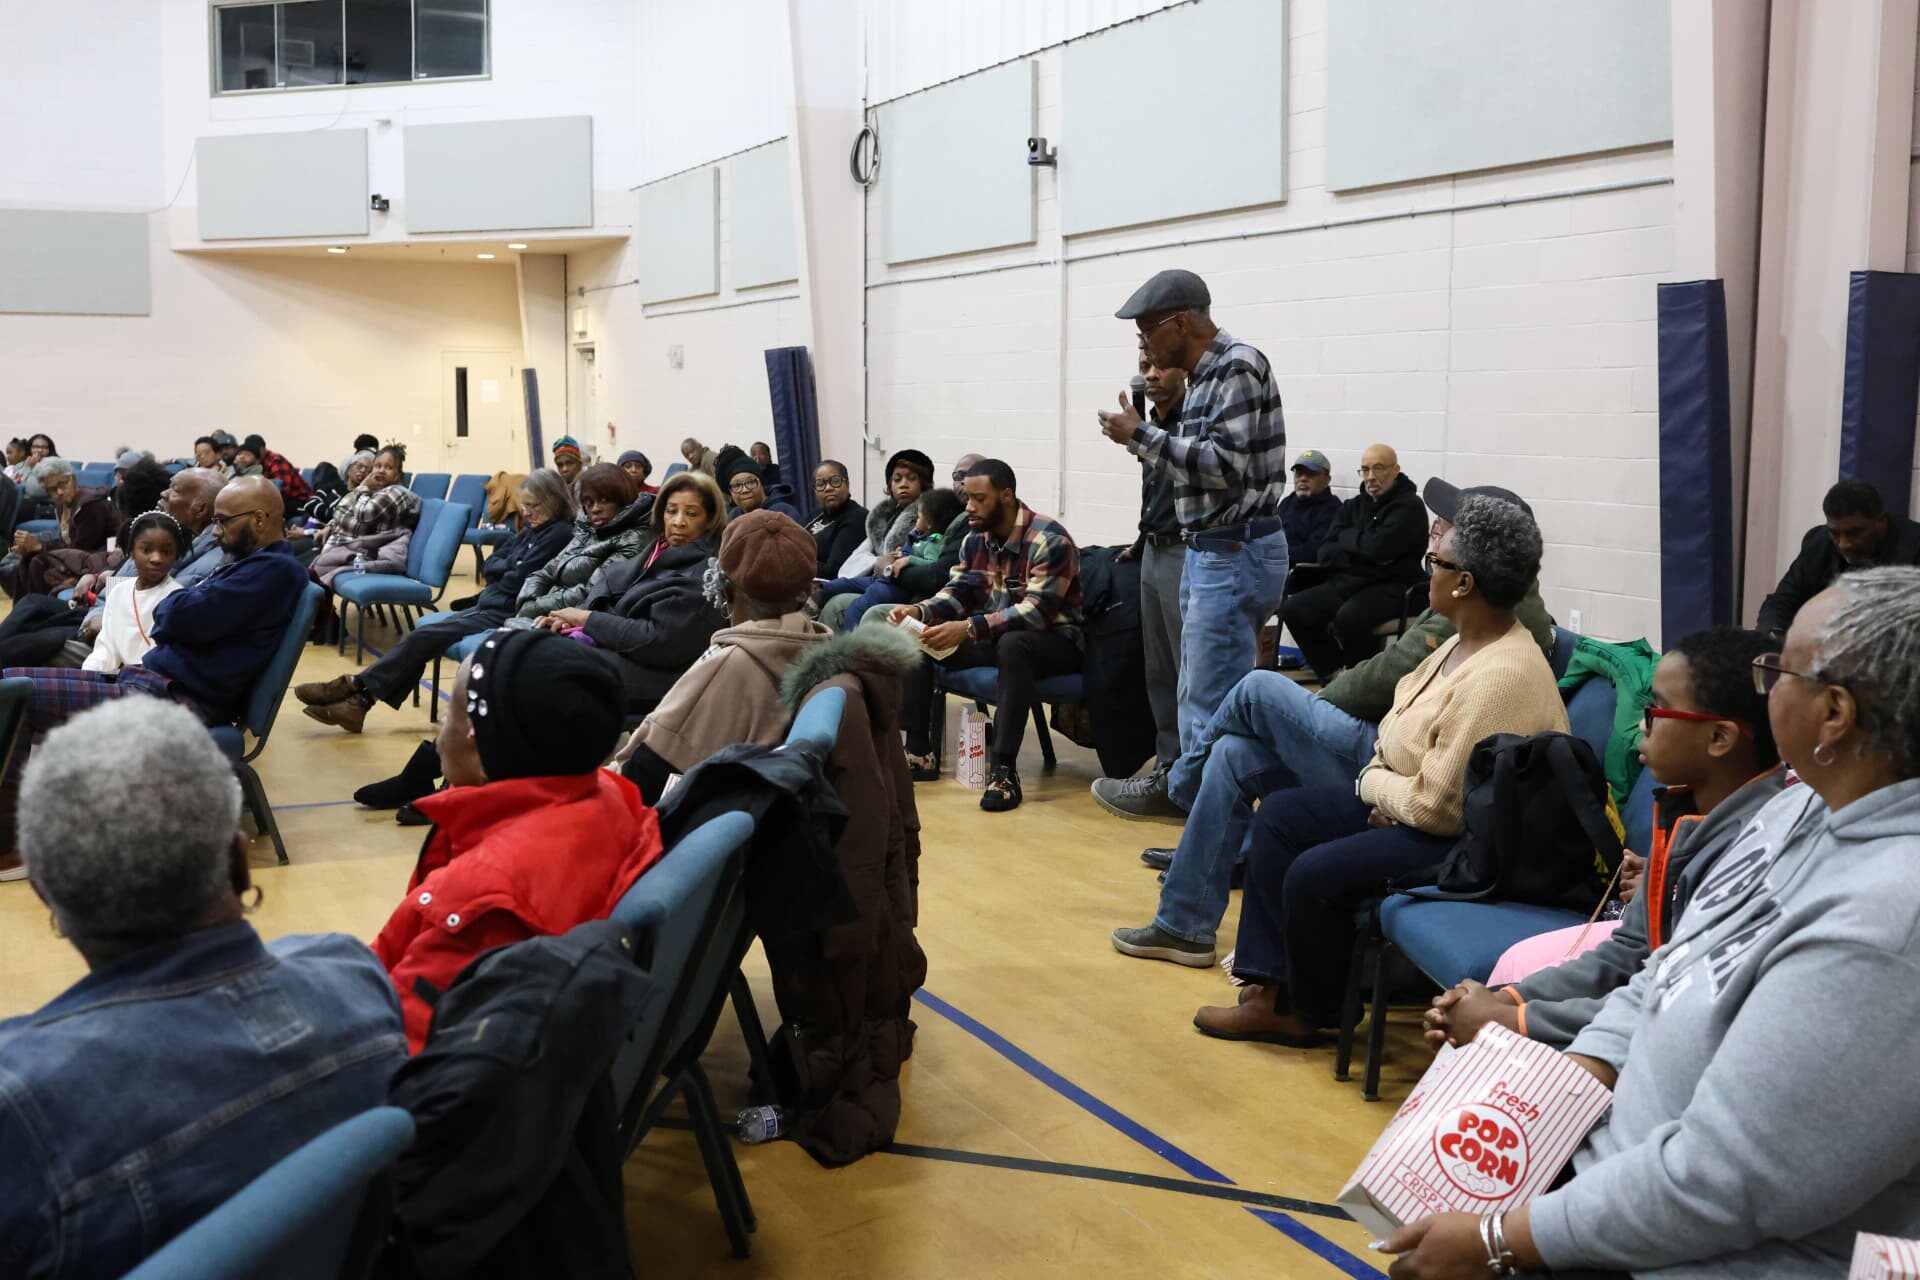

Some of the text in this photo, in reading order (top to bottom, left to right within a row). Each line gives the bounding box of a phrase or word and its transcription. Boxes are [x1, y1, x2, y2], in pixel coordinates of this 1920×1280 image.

[1487, 1081, 1540, 1122] fresh
[1458, 1110, 1519, 1151] POP
[1440, 1132, 1519, 1186] CORN
[1402, 1171, 1438, 1203] CRISP
